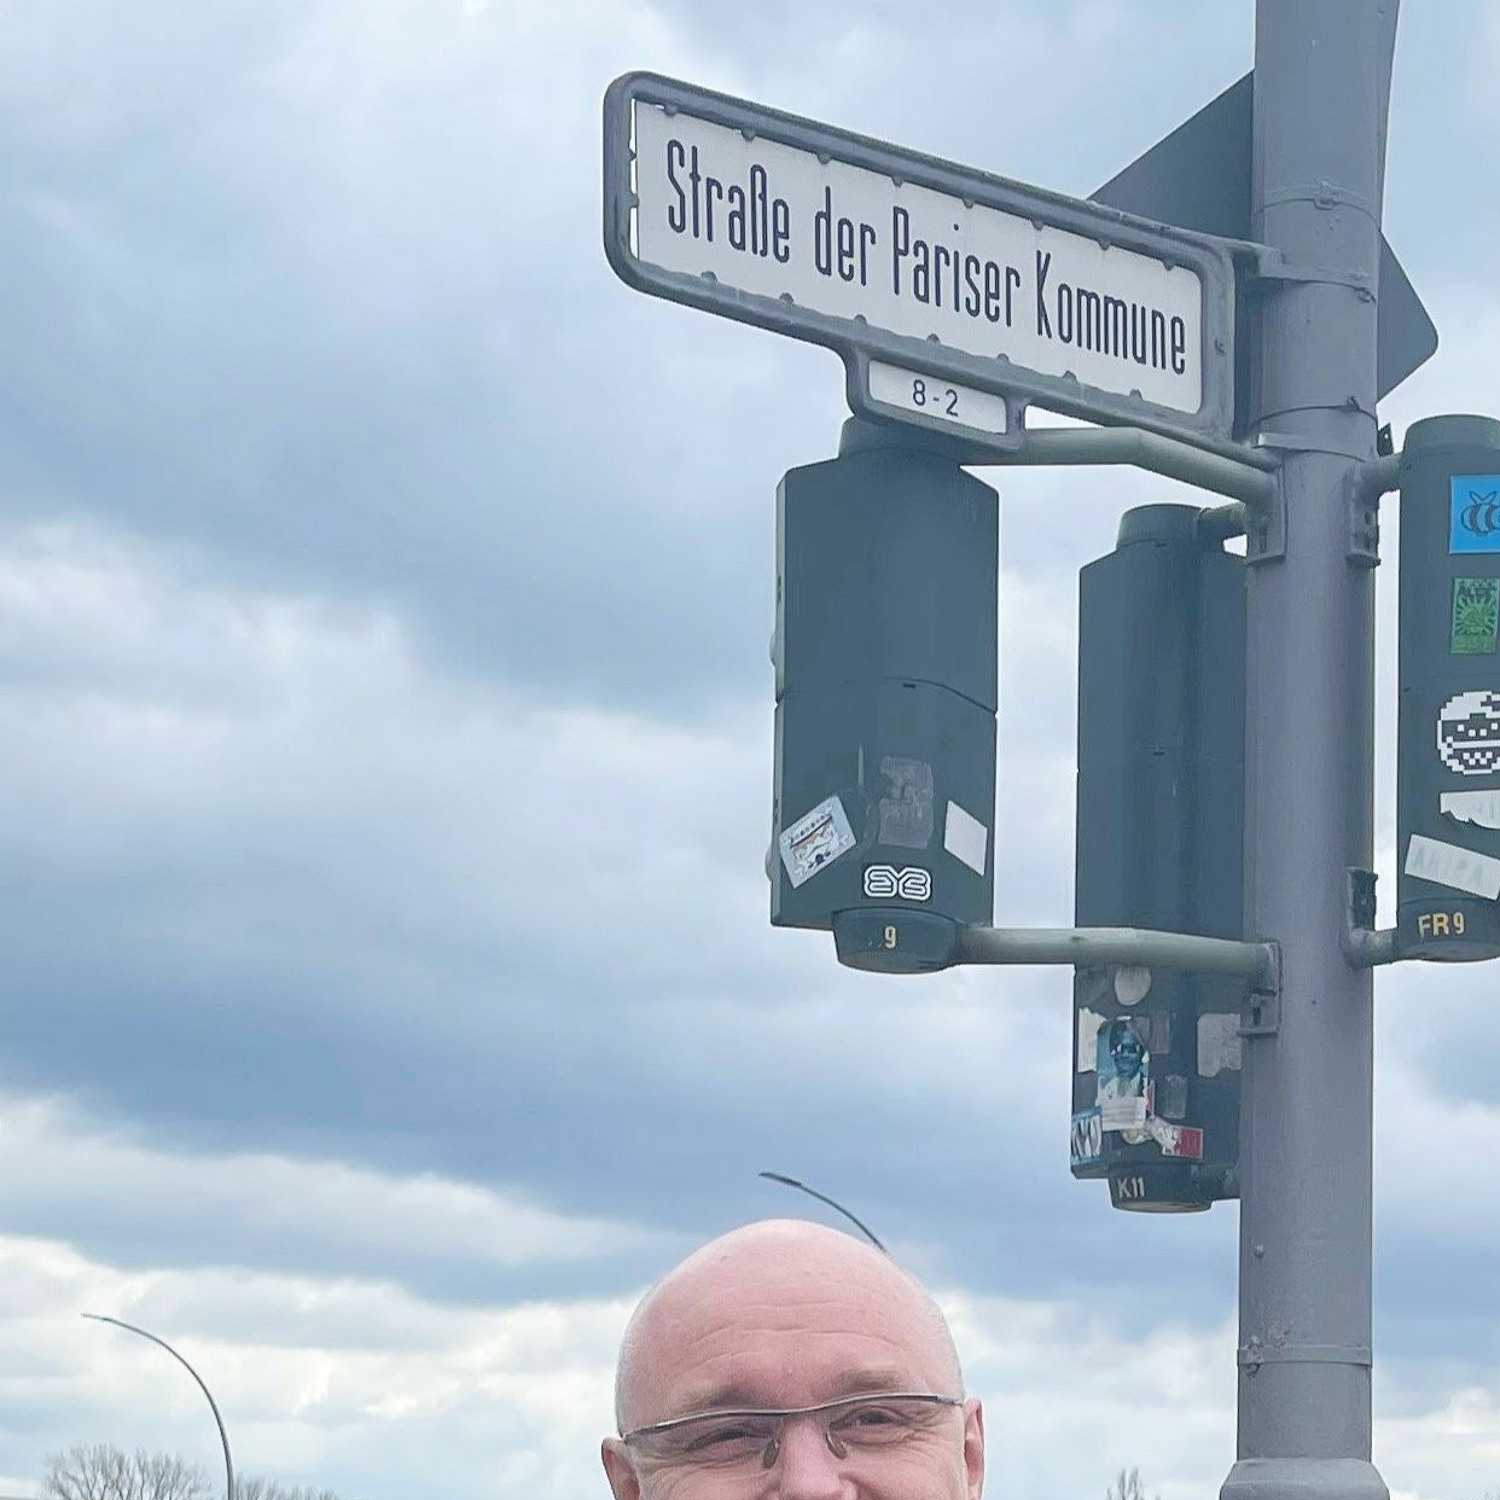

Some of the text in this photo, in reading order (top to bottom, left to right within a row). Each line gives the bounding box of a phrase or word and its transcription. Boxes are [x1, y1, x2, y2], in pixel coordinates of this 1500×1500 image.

[666, 138, 1187, 376] Straße der Pariser Kommune
[883, 925, 897, 949] 9
